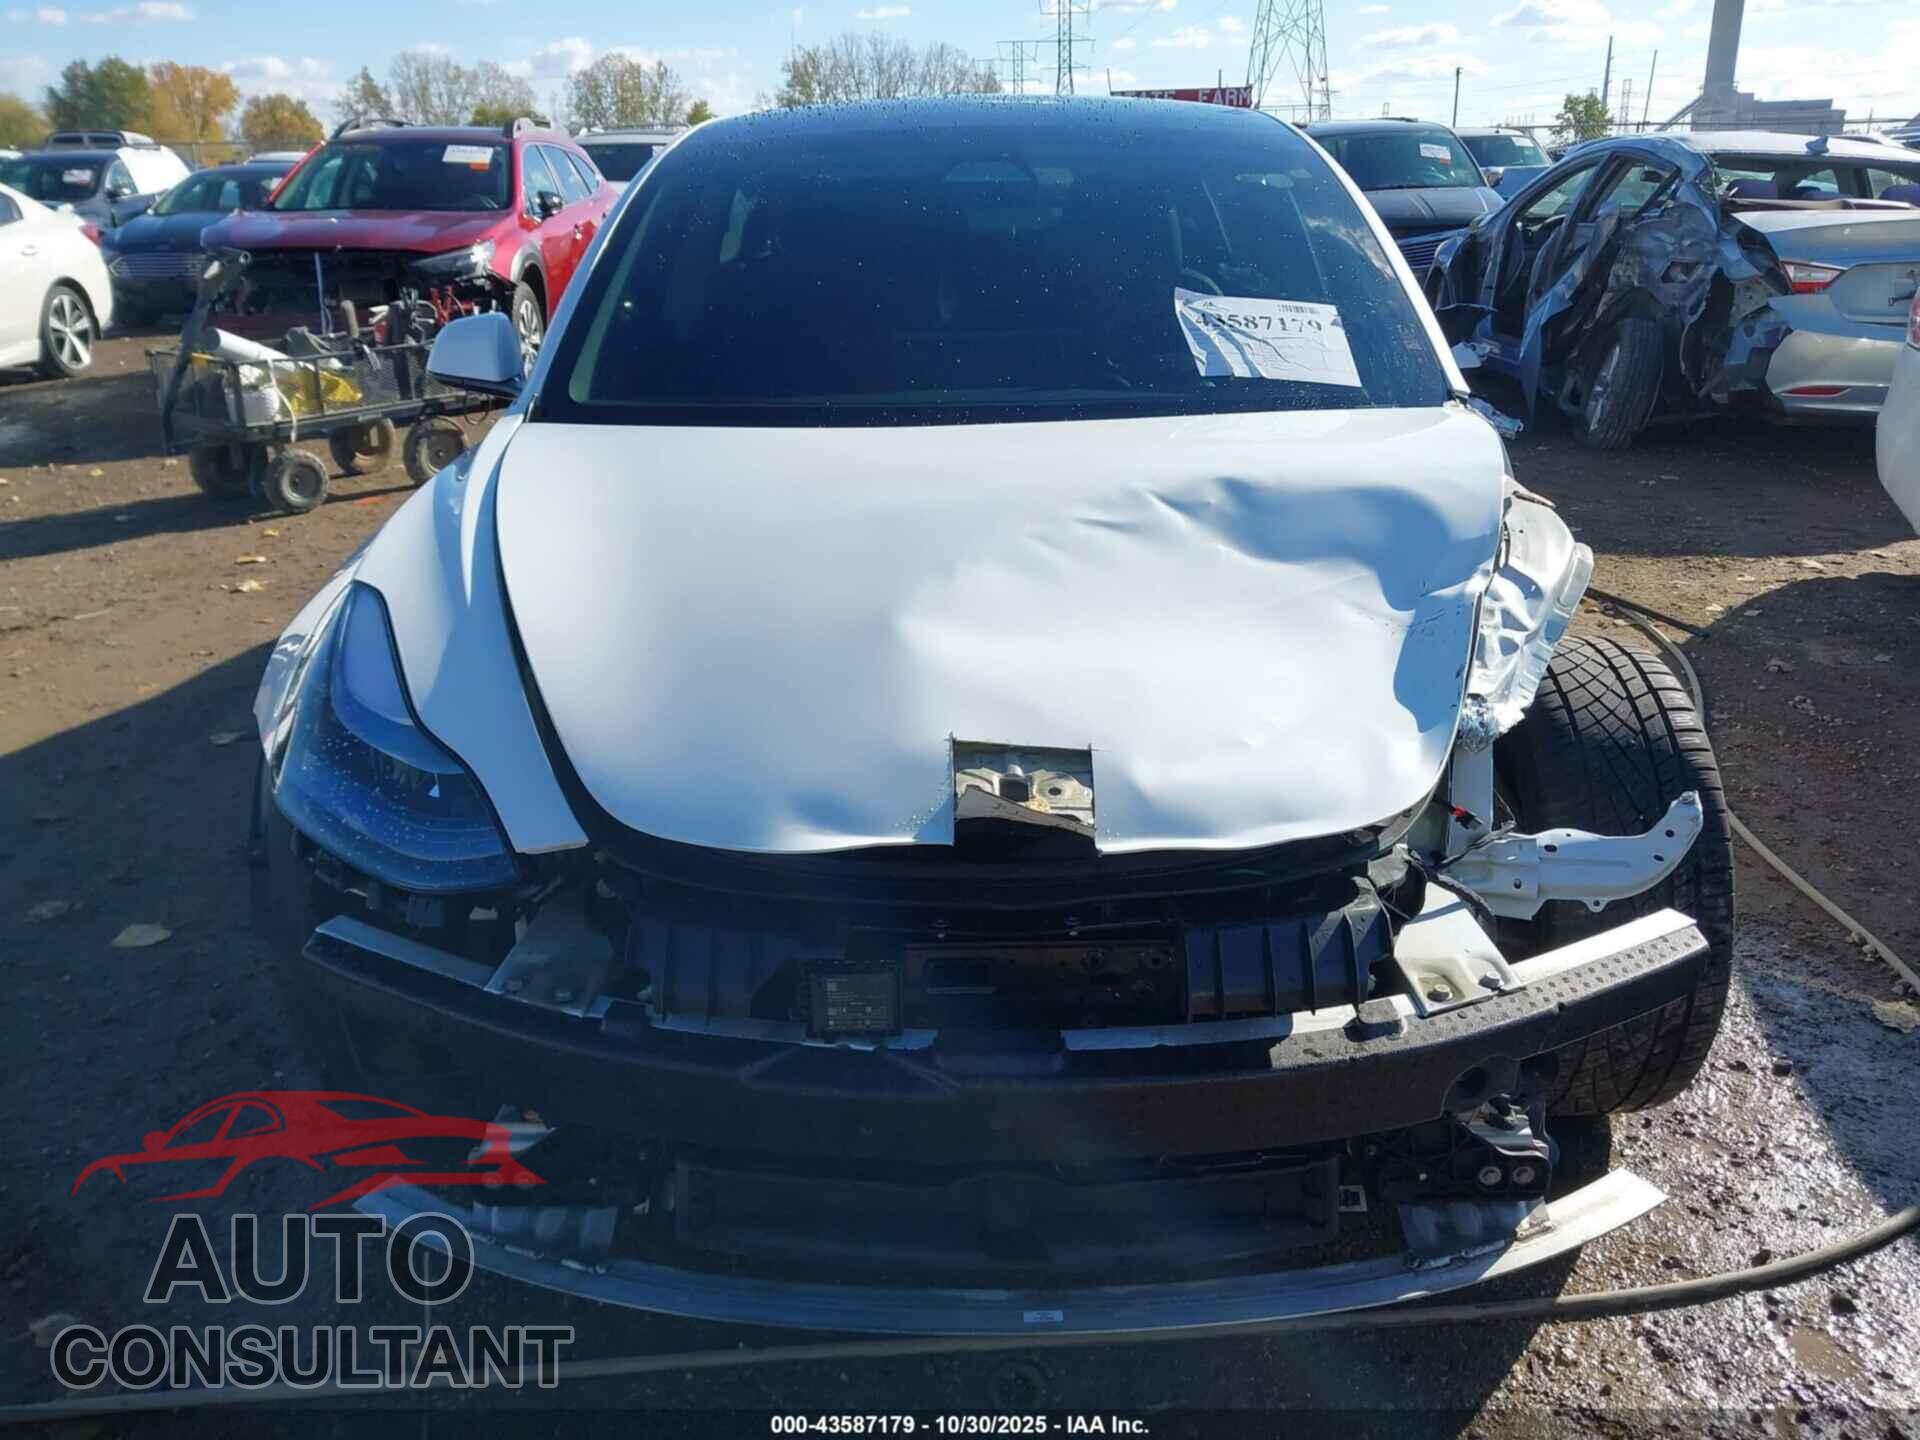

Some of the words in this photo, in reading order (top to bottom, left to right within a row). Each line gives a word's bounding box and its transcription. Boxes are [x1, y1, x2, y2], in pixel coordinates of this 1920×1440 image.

[1110, 91, 1176, 100] ATE
[1199, 88, 1250, 106] FARM
[1195, 312, 1322, 333] 43587179
